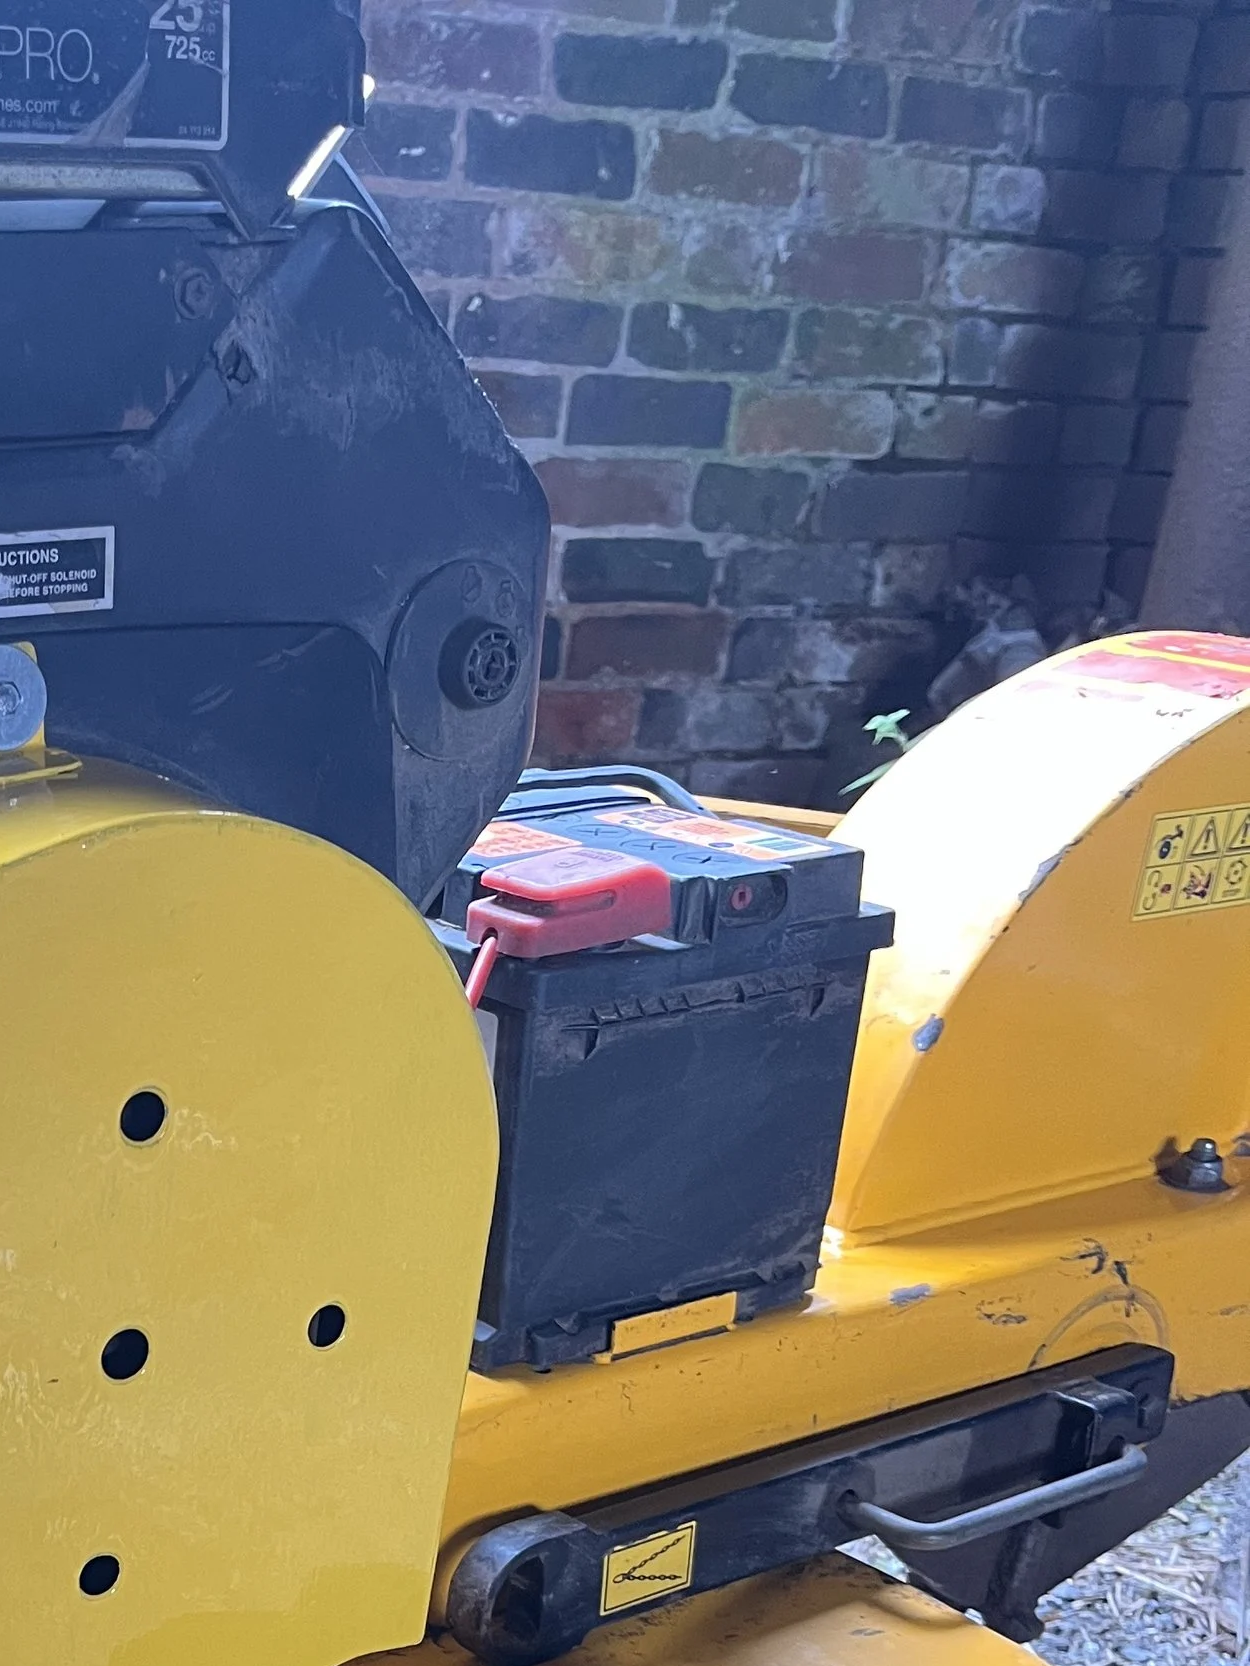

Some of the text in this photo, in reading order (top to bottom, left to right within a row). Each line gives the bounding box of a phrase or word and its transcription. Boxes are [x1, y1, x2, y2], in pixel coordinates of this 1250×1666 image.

[50, 569, 97, 582] SOLENOID
[4, 586, 40, 598] EFORE
[42, 583, 89, 595] STOPPING
